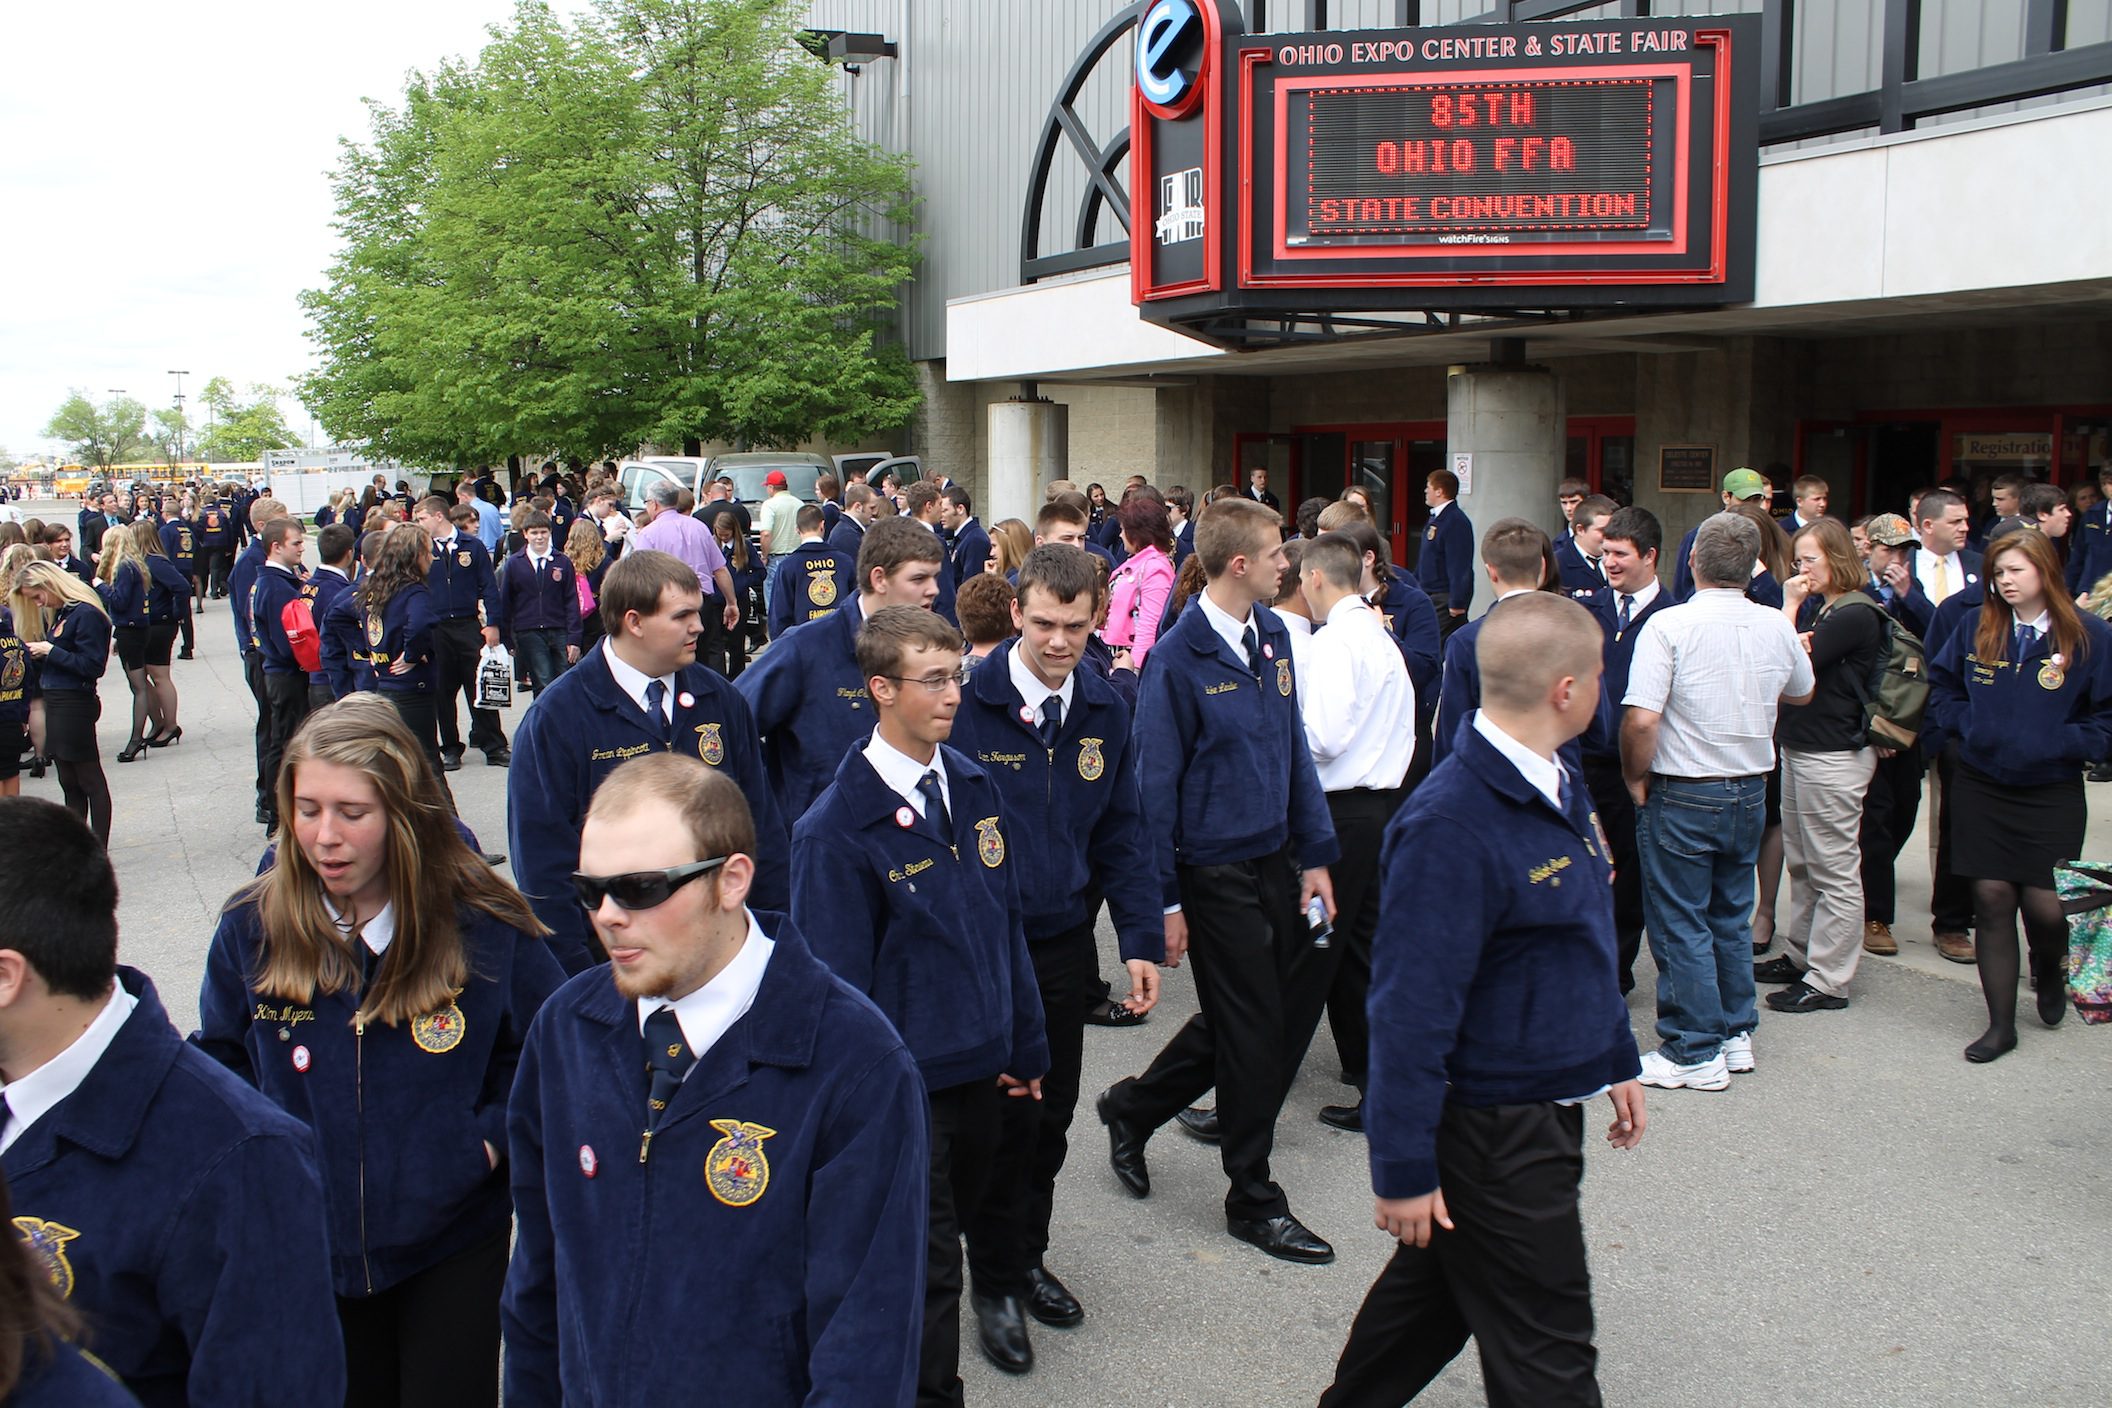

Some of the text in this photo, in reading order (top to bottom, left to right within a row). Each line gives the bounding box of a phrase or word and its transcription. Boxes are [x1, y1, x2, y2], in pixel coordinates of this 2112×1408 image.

[1278, 30, 1687, 66] OHIO EXPO CENTER & STATE FAIR
[1431, 92, 1533, 126] 85TH
[1376, 135, 1575, 174] OHIO FFA
[1320, 193, 1636, 221] STATE CONVENTION
[1969, 439, 2051, 459] Registratio
[805, 558, 835, 570] OHIO
